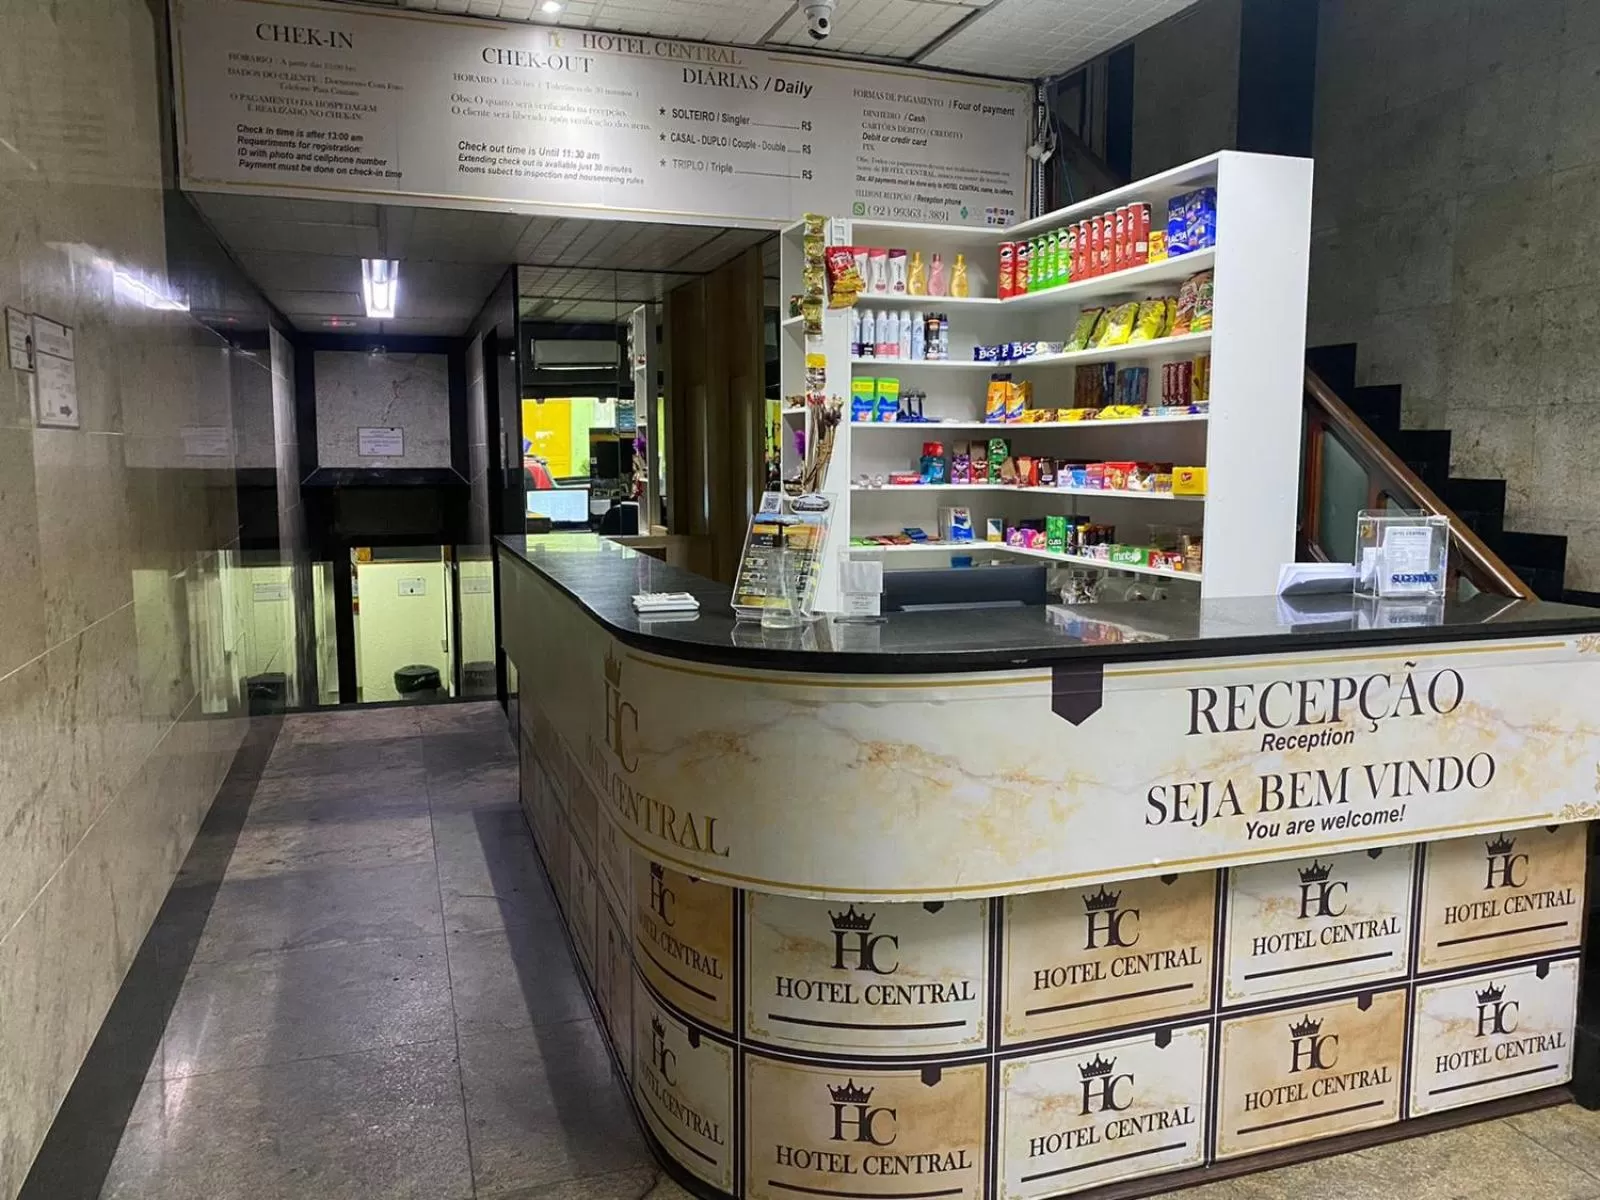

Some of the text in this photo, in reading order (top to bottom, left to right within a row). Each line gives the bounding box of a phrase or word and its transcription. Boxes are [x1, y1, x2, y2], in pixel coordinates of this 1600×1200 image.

[255, 22, 354, 50] CHEK-IN
[482, 47, 594, 74] CHEK-OUT
[582, 33, 650, 55] HOTEL
[655, 42, 742, 65] CENTRAL
[682, 67, 759, 91] DIÁRIAS
[774, 78, 813, 98] Daily
[240, 94, 299, 106] PAGAMENTO
[315, 100, 377, 113] HOSPEDAGEM
[255, 104, 308, 117] REALIZADO
[451, 106, 461, 115] O
[463, 107, 489, 118] cliente
[474, 95, 484, 105] O
[853, 90, 1015, 117] FORMAS DE PAGAMENTO Four of payment
[672, 108, 812, 132] SOLTEIRO Singler R$
[908, 113, 926, 123] Cash
[237, 124, 262, 134] Check
[265, 126, 274, 136] in
[276, 128, 294, 137] time
[296, 129, 304, 138] is
[306, 129, 326, 140] after
[670, 132, 812, 155] CASAL DUPLO Couple Double R$
[862, 132, 881, 142] Debit
[912, 138, 928, 147] card
[238, 146, 388, 168] ID with photo and cellphone number
[299, 141, 312, 150] for
[458, 140, 600, 161] Check out time is Until am
[238, 159, 403, 180] Payment must be done on check-in time
[458, 153, 633, 175] Extending check out is available just minutes
[458, 164, 486, 175] Rooms
[514, 169, 523, 178] to
[524, 169, 563, 182] inspection
[564, 172, 578, 182] and
[626, 176, 645, 186] rules
[672, 159, 813, 180] TRIPLO Triple R$
[943, 182, 958, 190] HOTEL
[873, 206, 885, 216] 92
[918, 194, 944, 205] Reception
[944, 198, 962, 206] phone
[1184, 661, 1465, 736] RECEPÇÃO
[1260, 728, 1355, 753] Reception
[1145, 751, 1496, 828] SEJA BEM VINDO
[611, 772, 730, 858] CENTRAL
[1245, 804, 1406, 842] You are welcome!
[1444, 888, 1576, 926] HOTEL CENTRAL
[1251, 916, 1401, 957] HOTEL CENTRAL
[660, 931, 724, 981] CENTRAL
[1033, 946, 1202, 992] HOTEL CENTRAL
[776, 976, 977, 1006] HOTEL CENTRAL
[1434, 1032, 1566, 1074] HOTEL CENTRAL
[1244, 1066, 1392, 1112] HOTEL CENTRAL
[662, 1088, 725, 1147] CENTRAL
[1029, 1106, 1195, 1158] HOTEL CENTRAL
[776, 1144, 973, 1176] HOTEL CENTRAL
